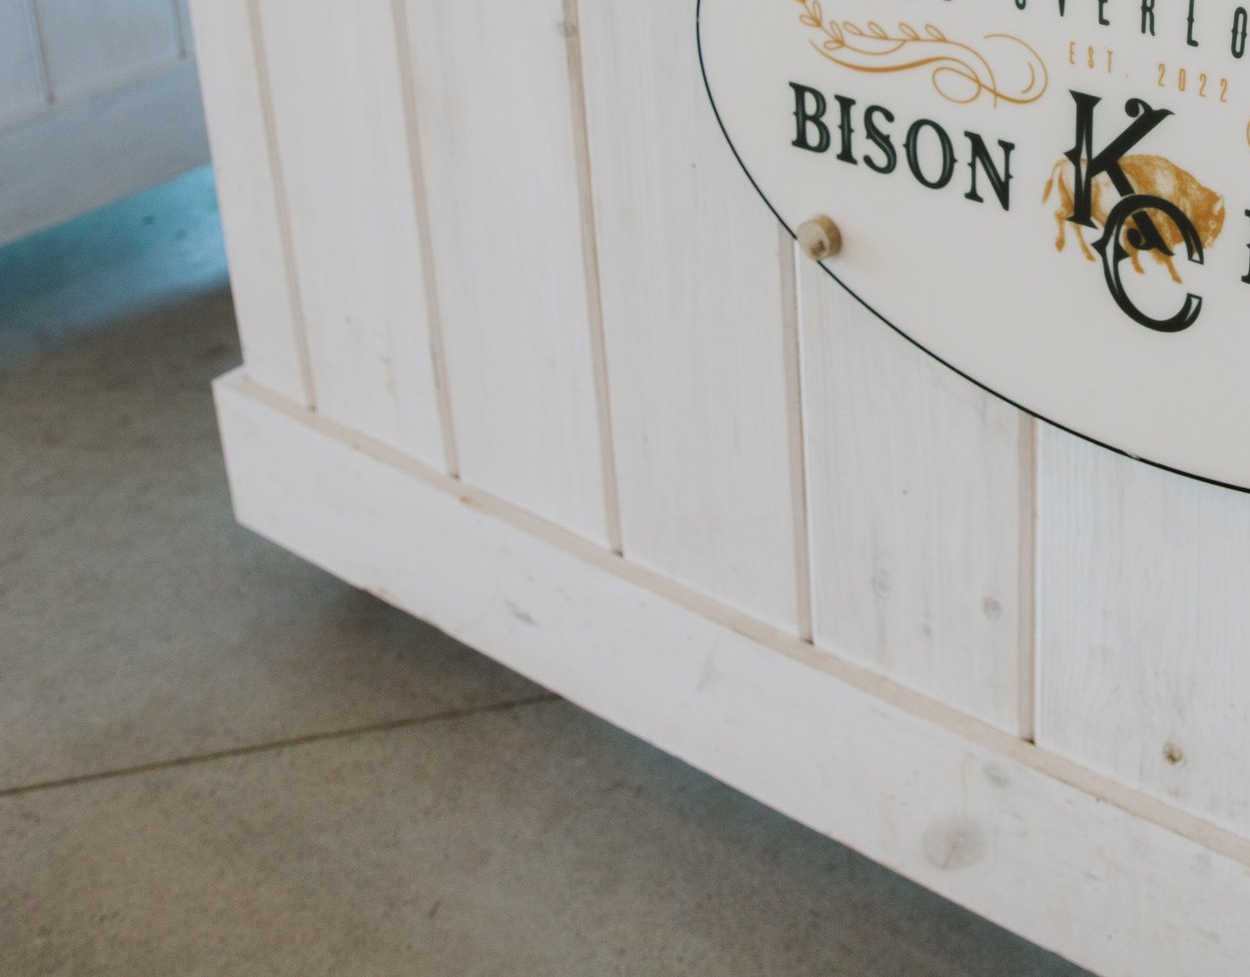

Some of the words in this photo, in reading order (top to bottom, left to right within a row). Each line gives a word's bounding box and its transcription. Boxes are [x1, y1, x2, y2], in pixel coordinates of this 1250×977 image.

[1068, 41, 1129, 78] EST.
[1157, 62, 1229, 103] 2022
[788, 81, 1016, 212] BISON
